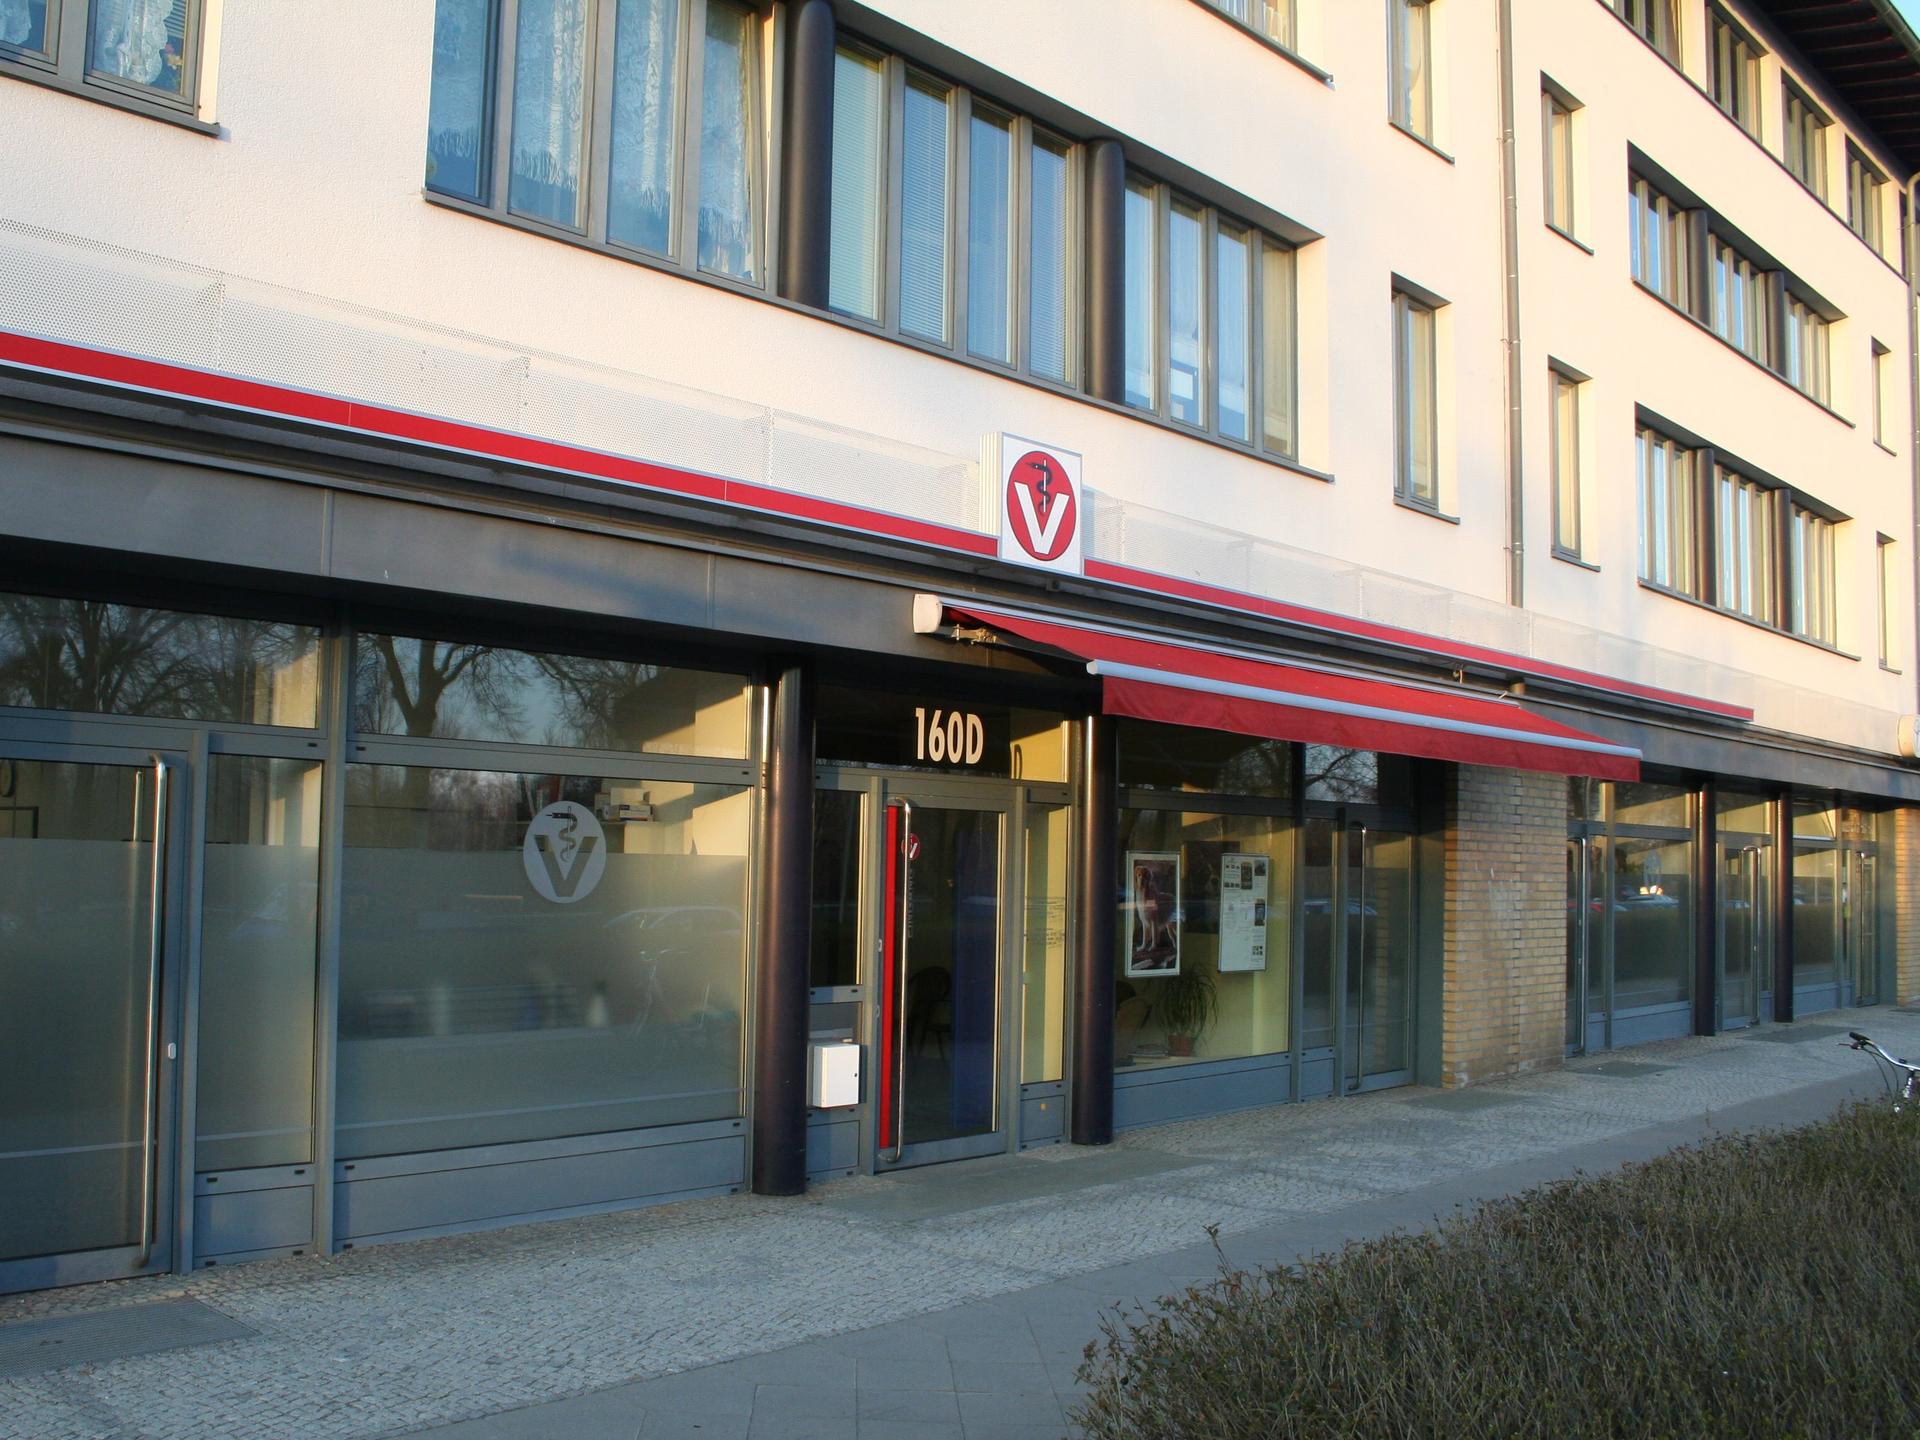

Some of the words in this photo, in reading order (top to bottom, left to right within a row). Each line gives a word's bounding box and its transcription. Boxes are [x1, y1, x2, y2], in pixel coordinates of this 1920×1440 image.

[1014, 481, 1070, 555] V
[915, 707, 984, 765] 160D
[533, 834, 599, 898] V
